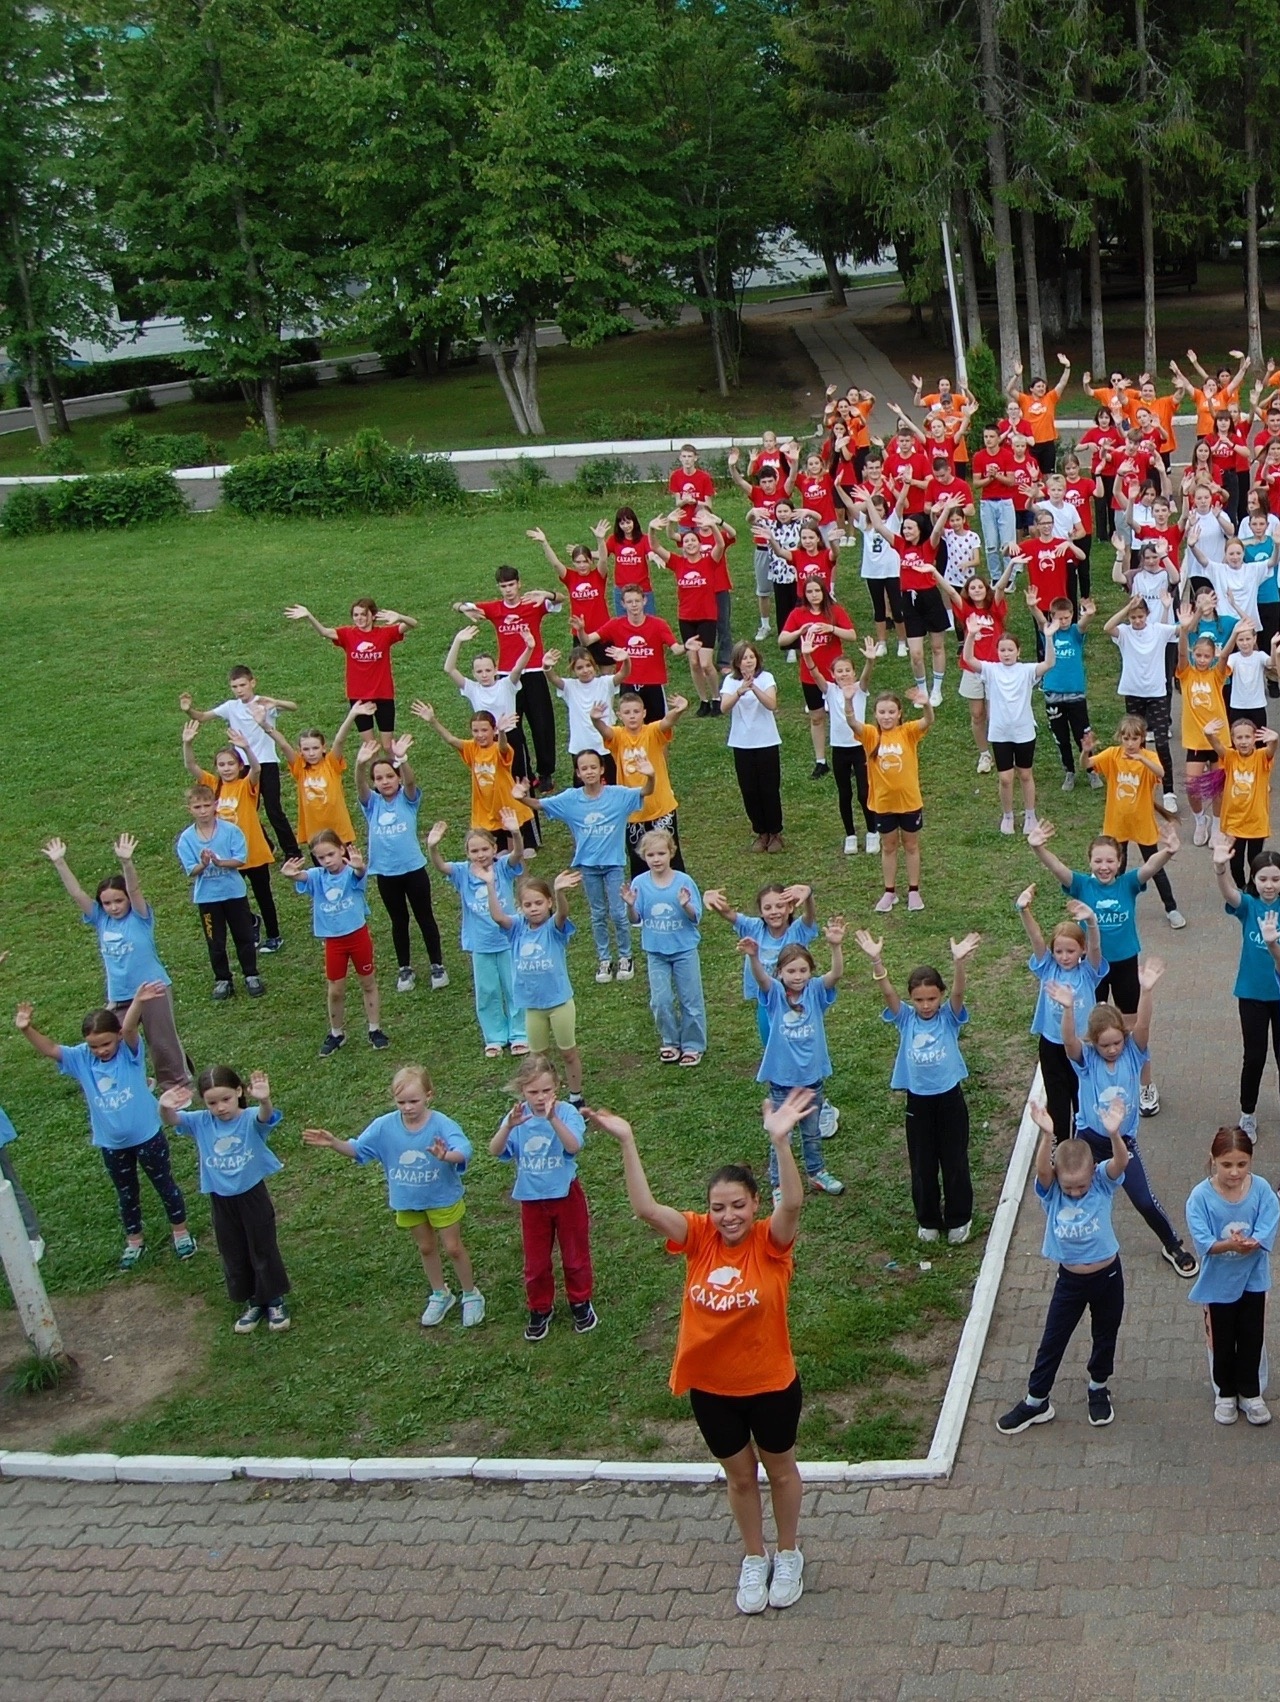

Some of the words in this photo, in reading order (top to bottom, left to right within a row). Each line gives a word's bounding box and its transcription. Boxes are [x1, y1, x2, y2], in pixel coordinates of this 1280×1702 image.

[643, 918, 683, 931] САХАРЕЖ
[389, 1168, 440, 1181] САХАРЕЖ
[690, 1284, 760, 1312] САХАРЕЖ
